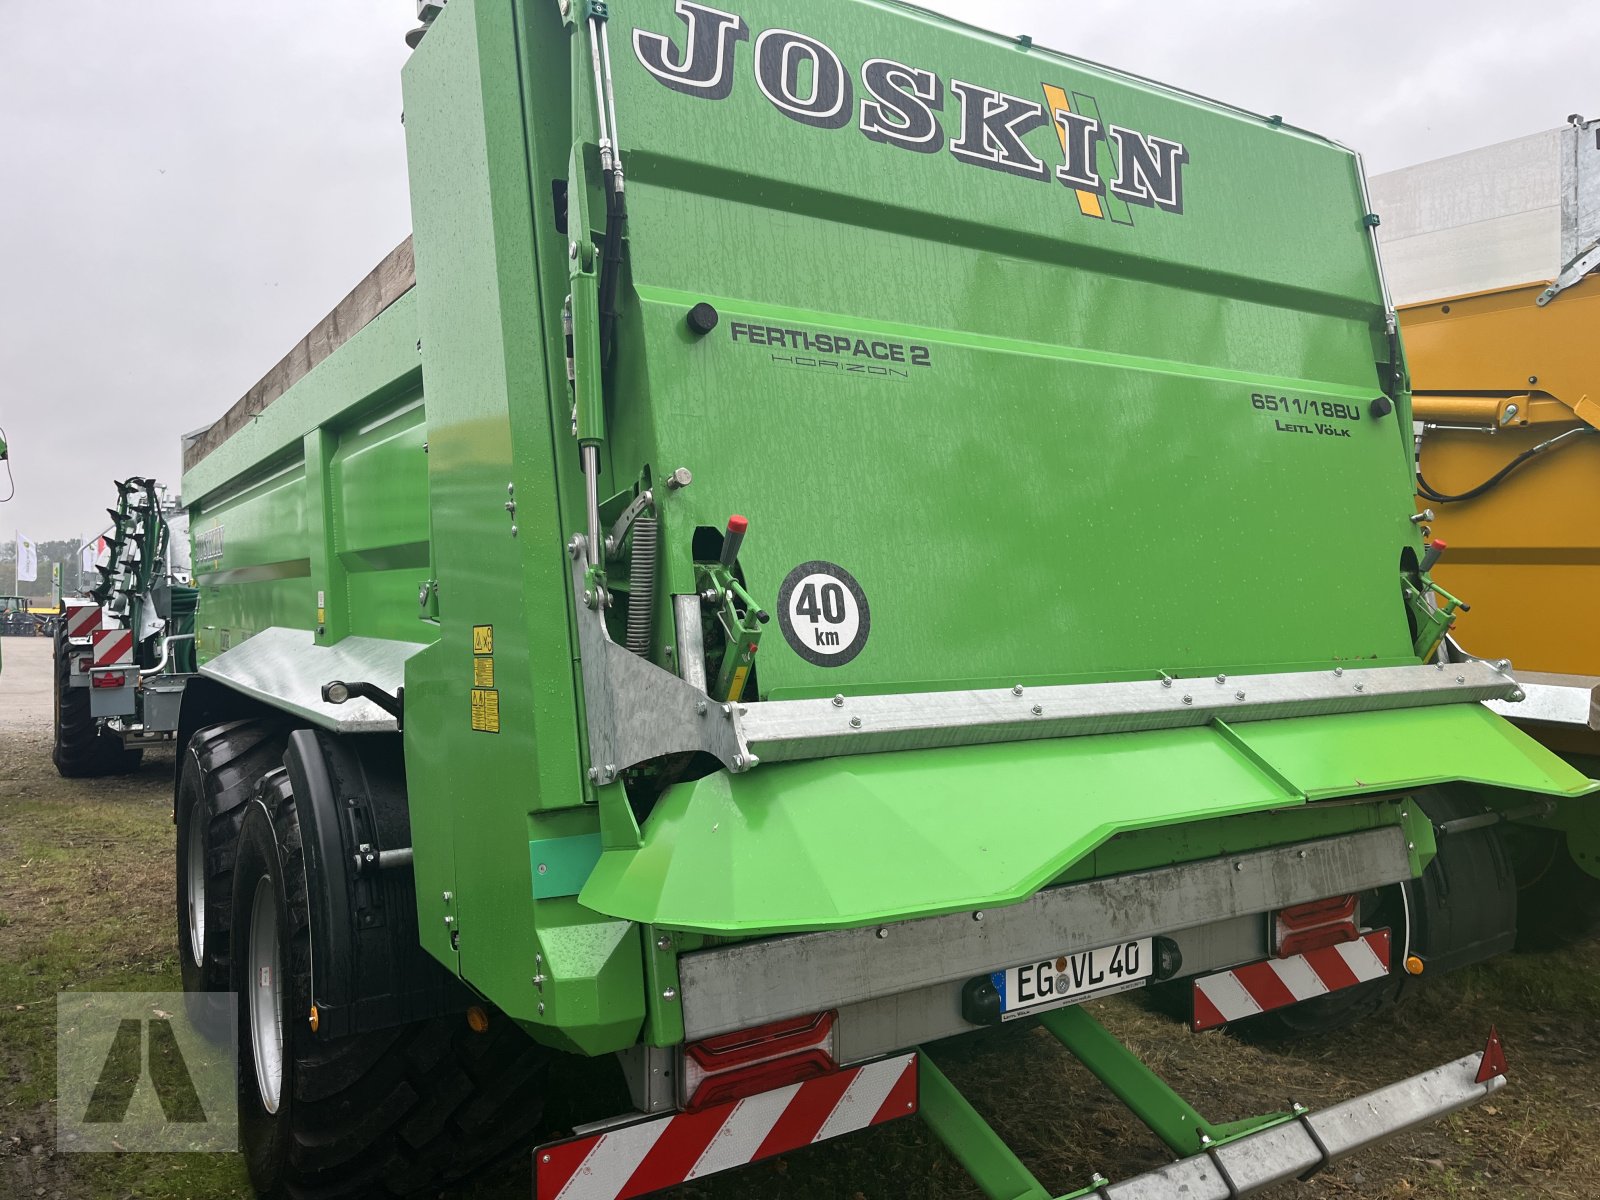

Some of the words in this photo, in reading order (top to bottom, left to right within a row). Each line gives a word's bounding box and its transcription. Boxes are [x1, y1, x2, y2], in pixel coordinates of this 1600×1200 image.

[632, 0, 1189, 215] JOSKIN
[730, 321, 906, 363] FERTI-SPACE
[909, 344, 932, 367] 2
[771, 353, 909, 378] HORIZON
[1251, 393, 1360, 420] 6511/18BU
[795, 582, 846, 625] 40
[814, 627, 840, 646] km
[1018, 961, 1054, 1002] EG
[1071, 951, 1105, 988] VL
[1109, 941, 1140, 977] 40
